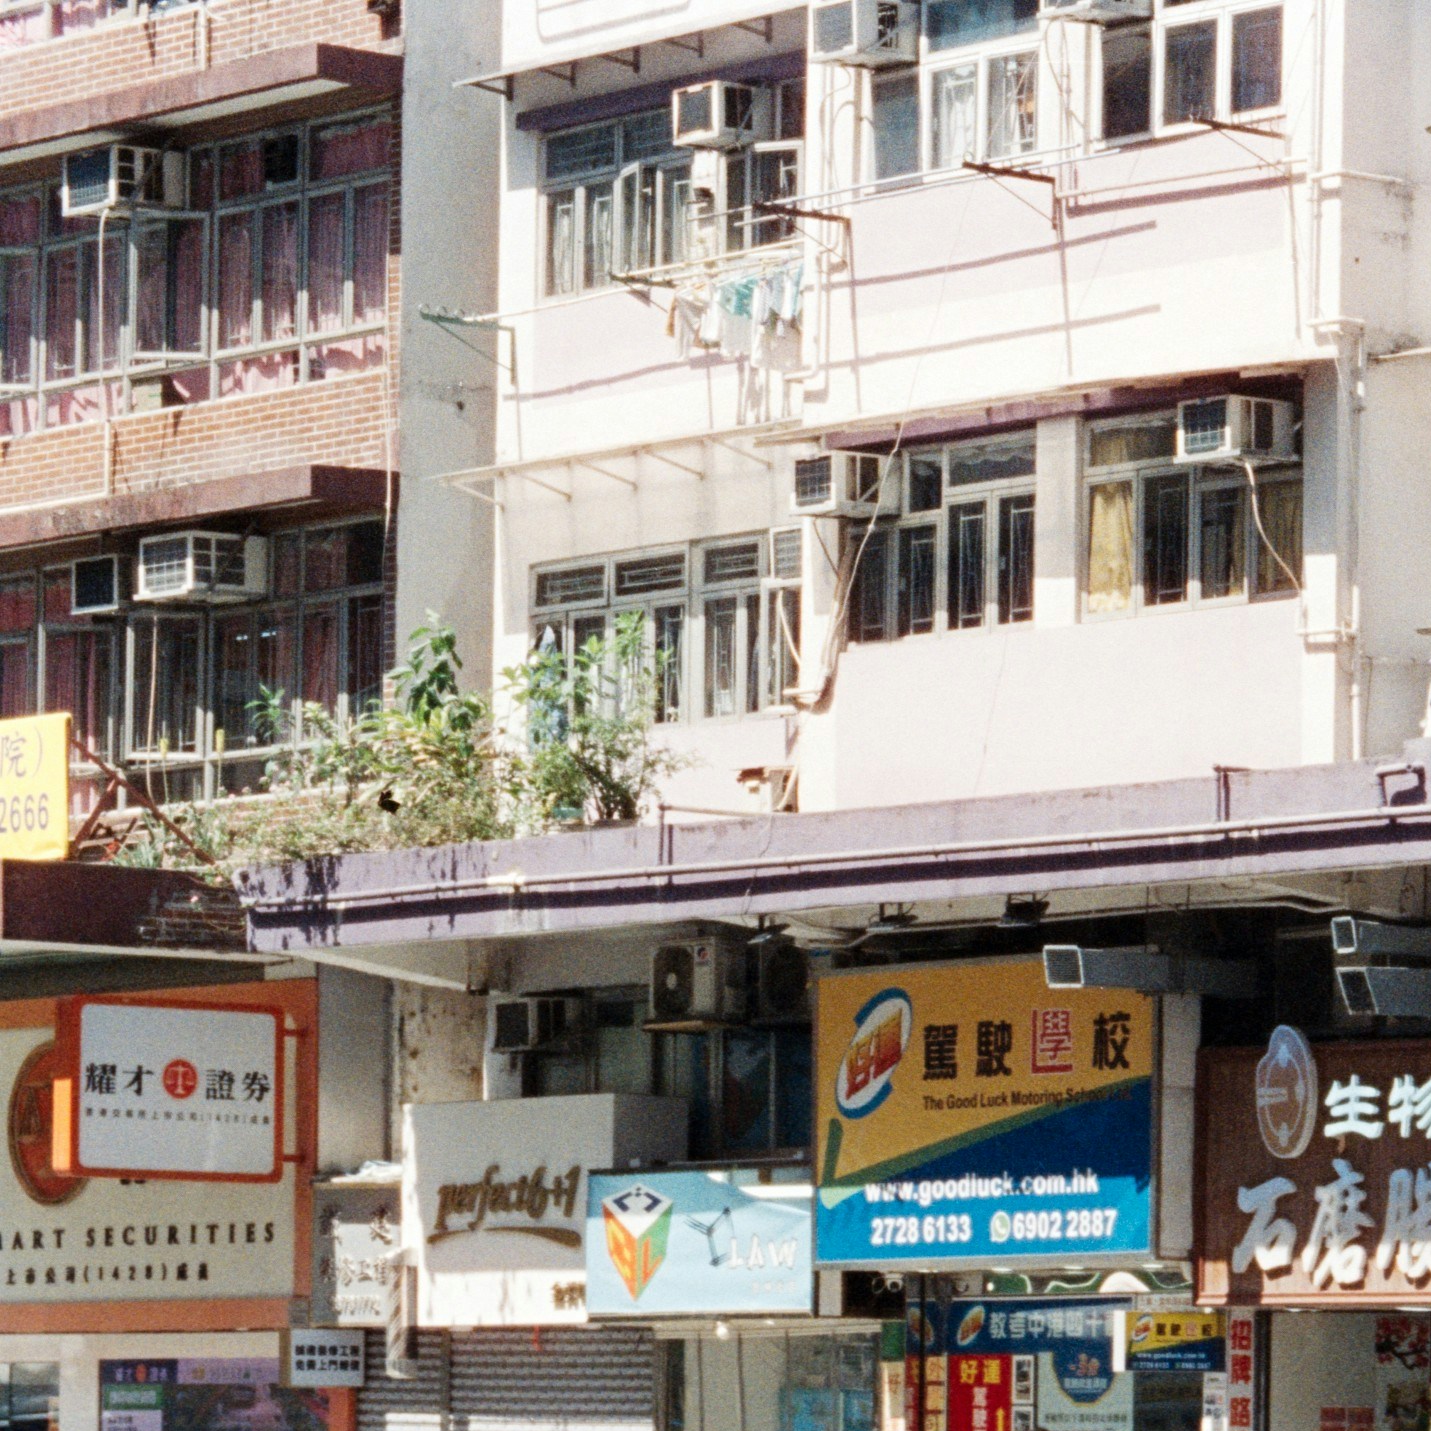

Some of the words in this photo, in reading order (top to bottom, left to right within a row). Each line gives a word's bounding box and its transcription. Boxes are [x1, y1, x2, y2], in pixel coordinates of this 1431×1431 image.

[922, 1008, 1132, 1082] 駕駛學校
[84, 1062, 155, 1096] 耀才
[205, 1068, 271, 1103] 證券
[923, 1095, 944, 1111] The
[946, 1093, 977, 1110] Good
[979, 1091, 1009, 1108] Luck
[1010, 1088, 1063, 1107] Motoring
[864, 1168, 1099, 1207] www.goodluck.com.hk
[0, 1229, 65, 1251] ART
[86, 1221, 275, 1248] SECURITIES
[870, 1217, 918, 1246] 2728
[922, 1214, 973, 1244] 6133
[1012, 1211, 1063, 1240] 6902
[1065, 1208, 1118, 1239] 2887
